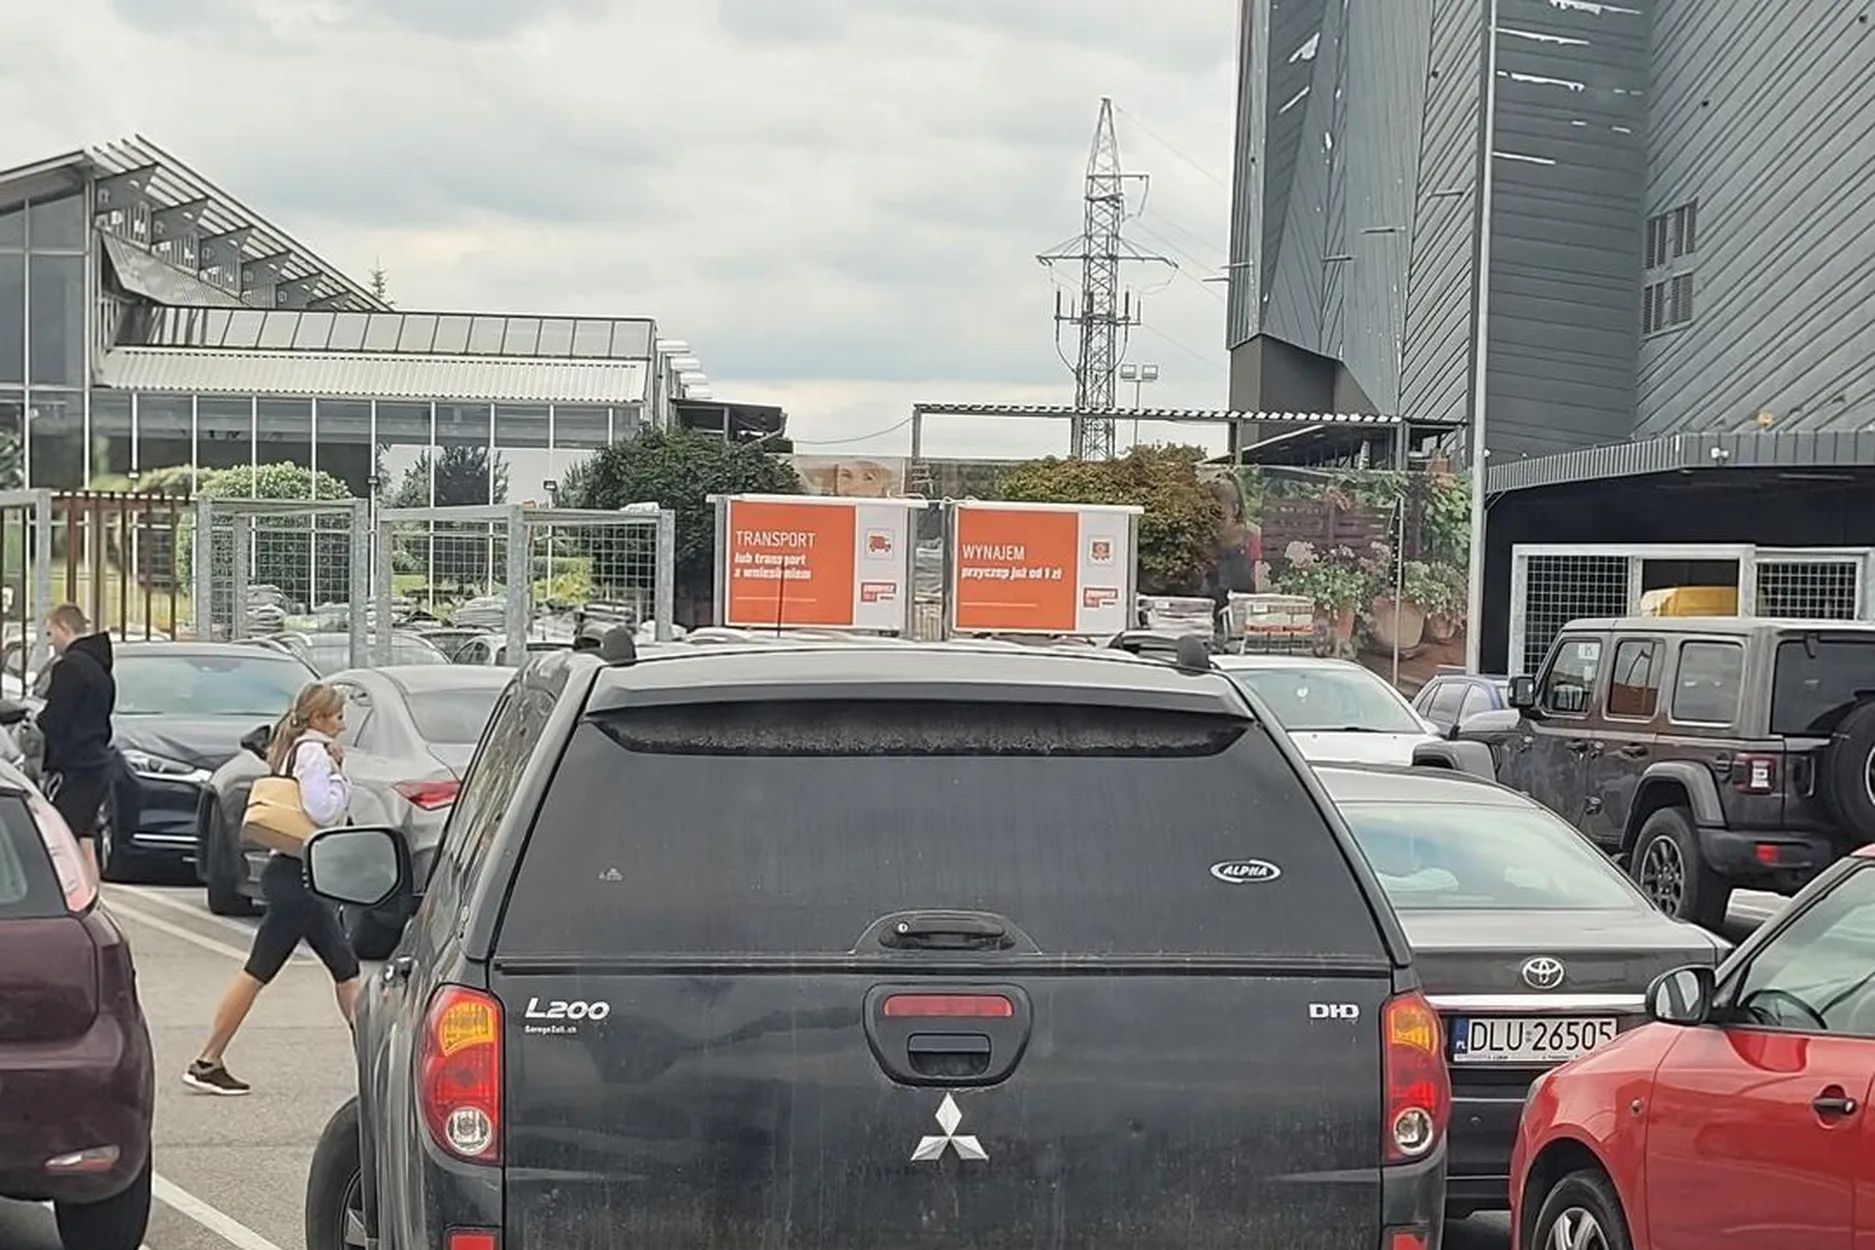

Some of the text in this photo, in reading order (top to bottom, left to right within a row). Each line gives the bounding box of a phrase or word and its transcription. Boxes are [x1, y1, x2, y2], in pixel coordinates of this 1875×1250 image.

[736, 531, 816, 548] TRANSPORT
[735, 552, 806, 566] lub transport
[962, 544, 1025, 560] WYNAJEM
[734, 568, 811, 580] z wniesiniem
[1029, 568, 1042, 579] od
[1223, 866, 1267, 876] ALPHA
[525, 997, 610, 1020] L200
[1471, 1021, 1611, 1051] DLU 26505
